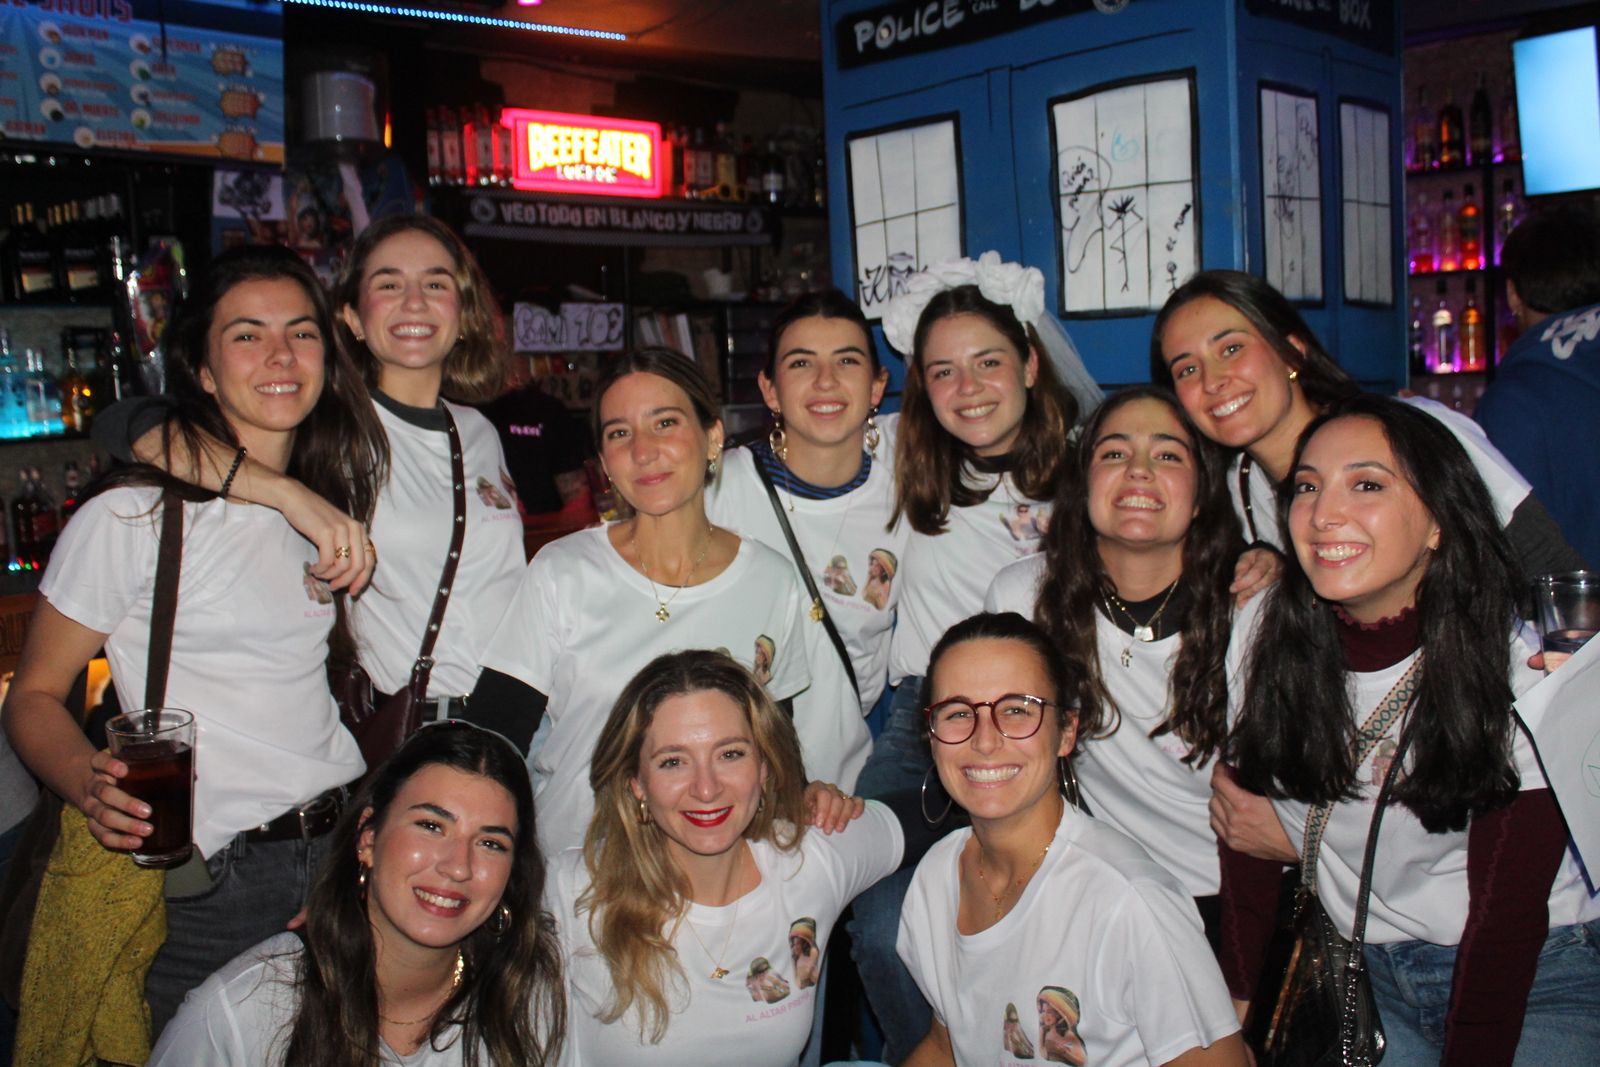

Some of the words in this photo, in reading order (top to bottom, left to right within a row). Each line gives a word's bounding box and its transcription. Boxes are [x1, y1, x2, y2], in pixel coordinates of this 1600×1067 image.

[853, 2, 964, 53] POLICE
[527, 122, 651, 180] BEEFEATER
[501, 203, 536, 224] VEO
[536, 204, 581, 227] TODO
[584, 206, 607, 227] EN
[609, 208, 675, 231] BLANCO
[692, 212, 744, 233] NEGRO
